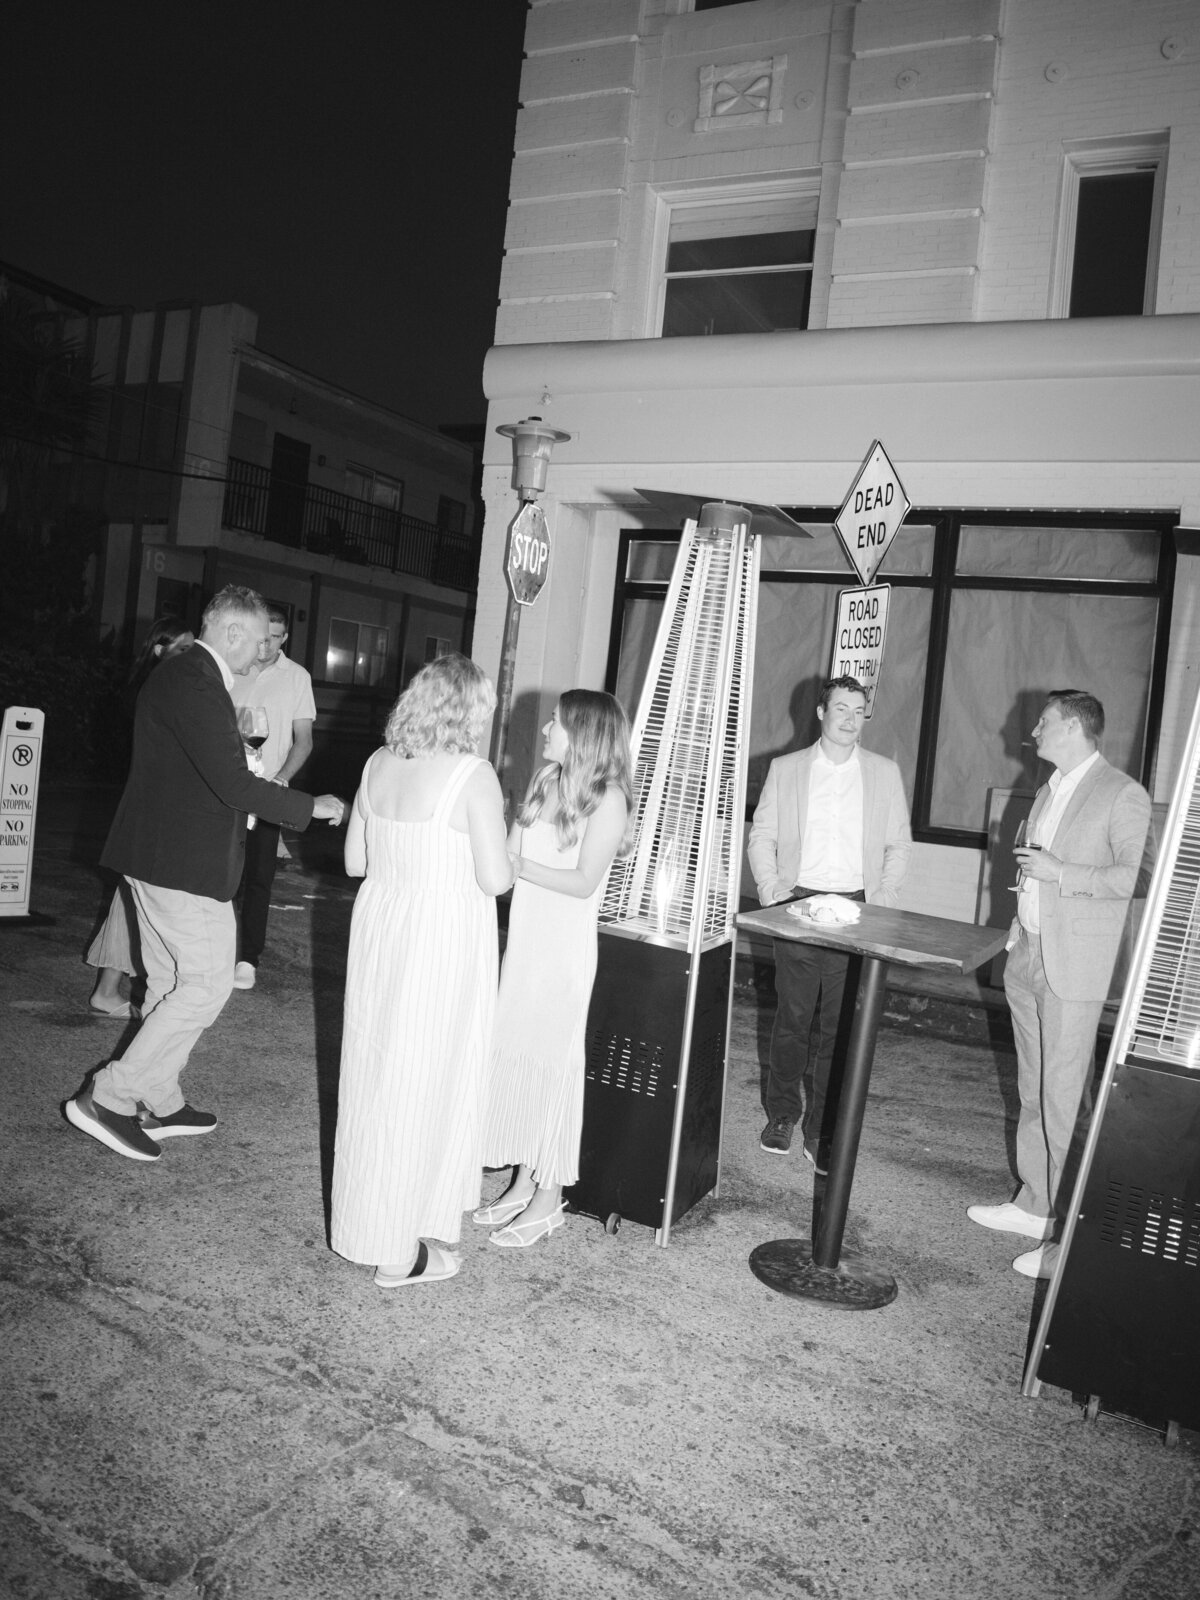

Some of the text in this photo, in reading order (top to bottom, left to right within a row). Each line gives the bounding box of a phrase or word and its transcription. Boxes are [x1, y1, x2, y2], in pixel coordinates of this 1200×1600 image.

[854, 482, 894, 514] DEAD
[857, 521, 886, 549] END
[146, 549, 166, 572] 16
[512, 533, 548, 575] STOP
[848, 597, 879, 622] ROAD
[840, 626, 882, 650] CLOSED
[839, 658, 877, 677] TO THRU
[9, 784, 28, 796] NO
[2, 798, 32, 810] STOPPING
[4, 820, 24, 832] NO
[0, 834, 28, 847] PARKING
